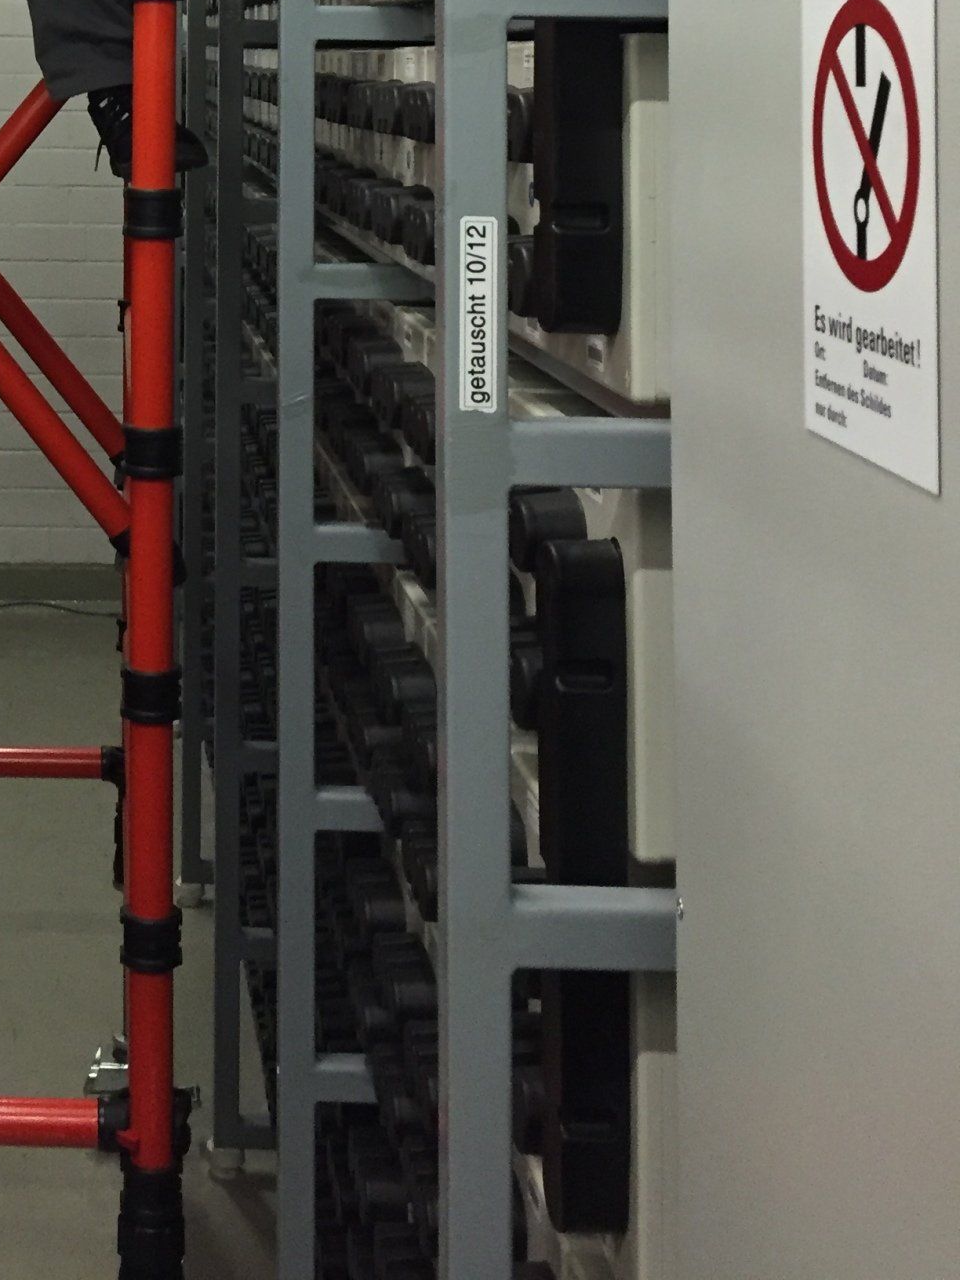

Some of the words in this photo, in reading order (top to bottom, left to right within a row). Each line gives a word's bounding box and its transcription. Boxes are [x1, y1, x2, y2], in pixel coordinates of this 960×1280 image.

[466, 225, 486, 285] 10/12
[466, 294, 490, 404] getauscht
[814, 304, 826, 333] Es
[828, 312, 853, 343] wird
